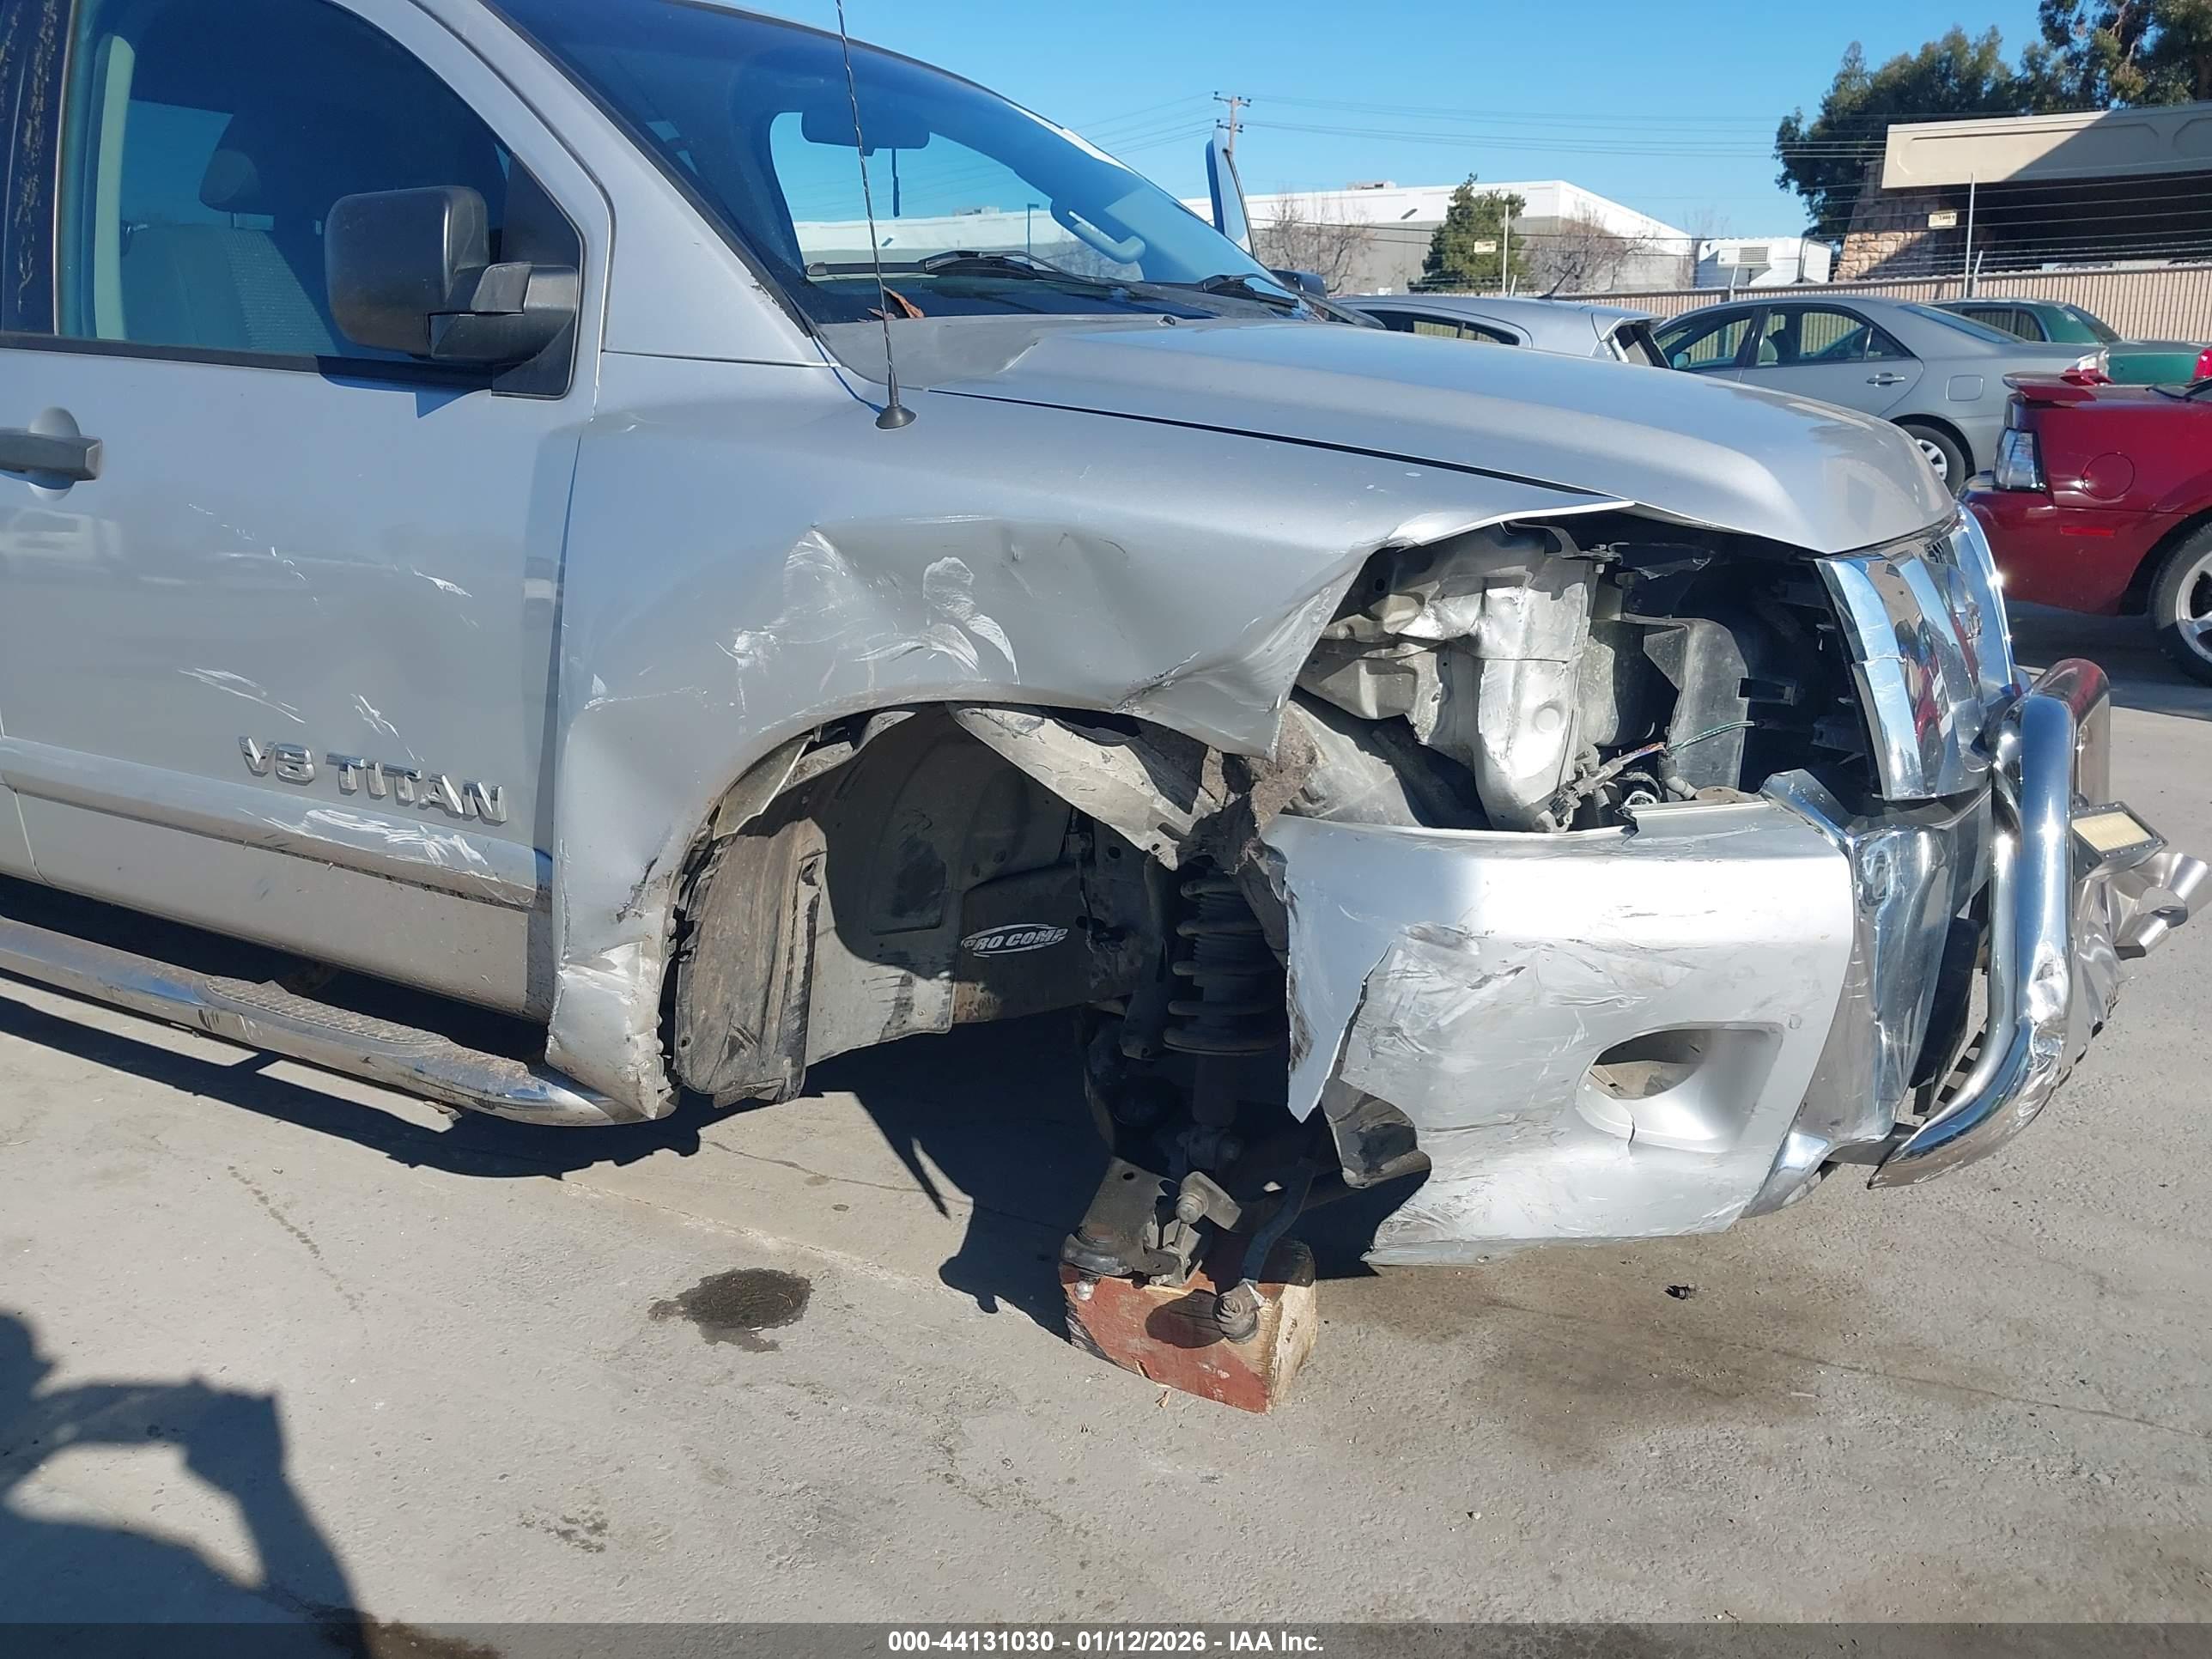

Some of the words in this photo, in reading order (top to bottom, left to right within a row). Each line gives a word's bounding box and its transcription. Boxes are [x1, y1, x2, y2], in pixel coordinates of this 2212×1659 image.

[239, 736, 315, 785] V8
[326, 752, 507, 823] TITAN
[963, 935, 1005, 951] PRO
[1006, 928, 1069, 947] COMP
